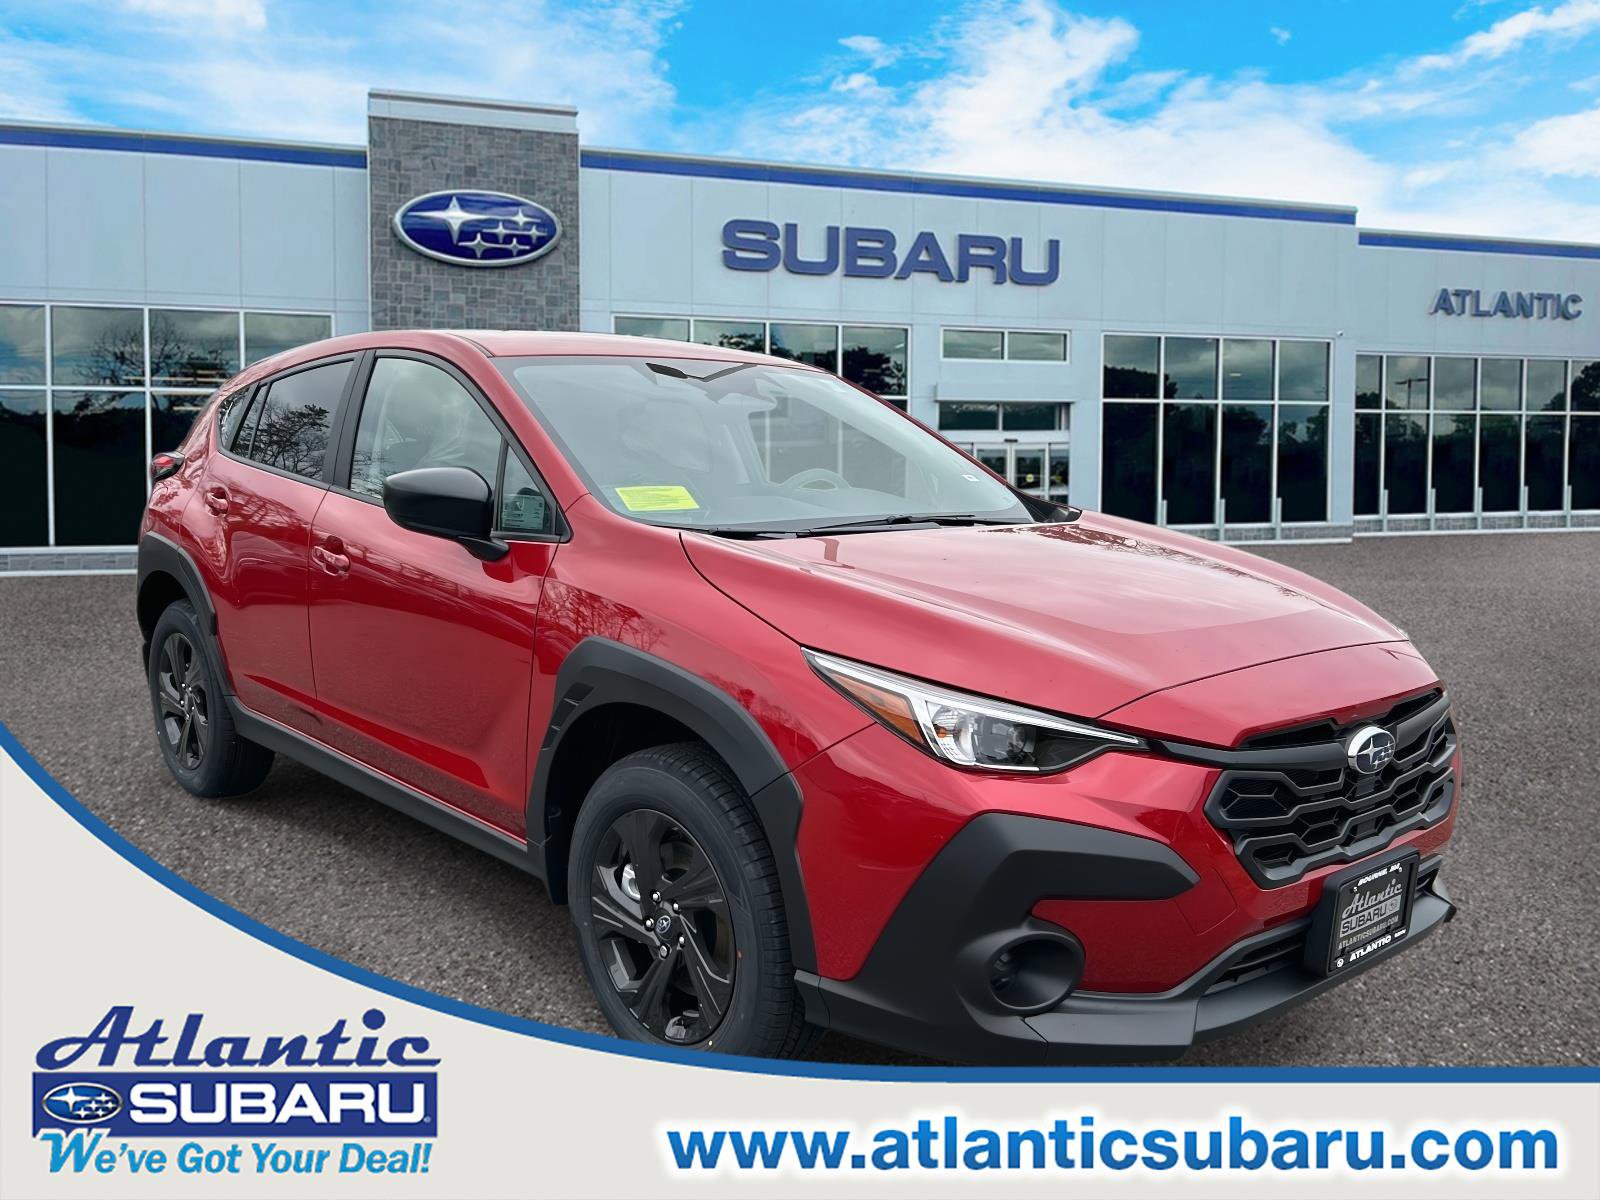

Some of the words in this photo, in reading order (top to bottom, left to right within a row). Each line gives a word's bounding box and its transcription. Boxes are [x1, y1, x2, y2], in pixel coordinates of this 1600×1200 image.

[722, 218, 1062, 287] SUBARU
[1429, 287, 1584, 321] ATLANTIC
[1341, 878, 1403, 920] Atlantic
[1342, 901, 1388, 935] SUBARU
[1349, 934, 1392, 962] ATLANTIC
